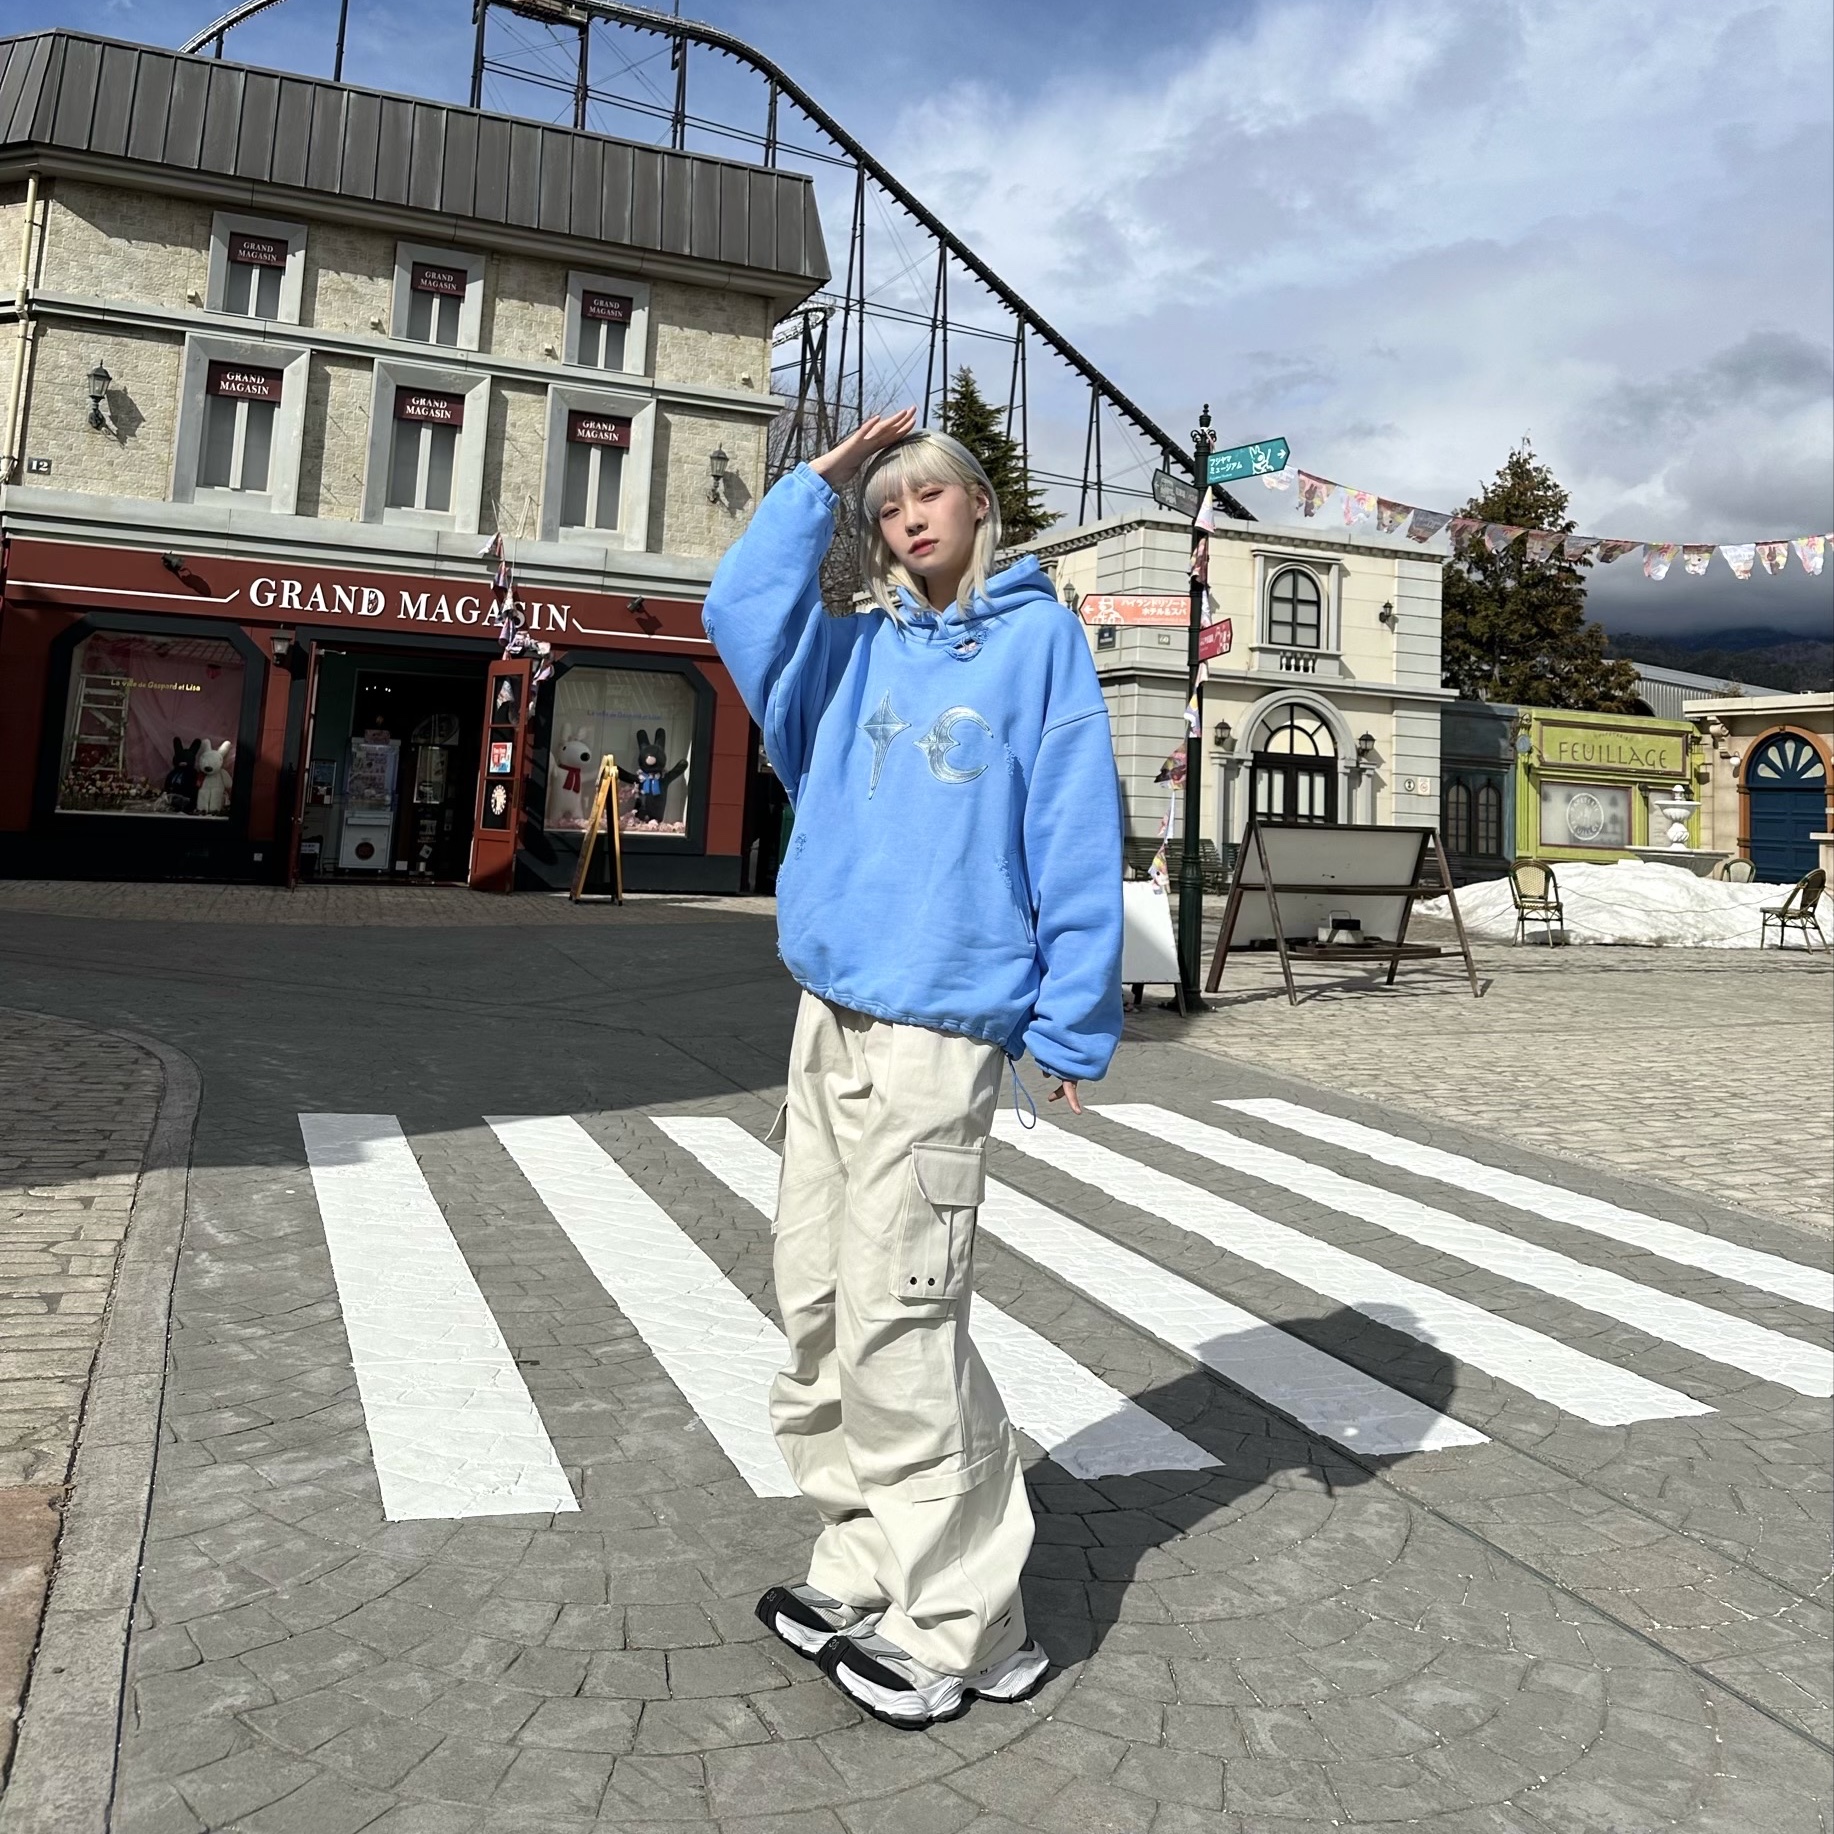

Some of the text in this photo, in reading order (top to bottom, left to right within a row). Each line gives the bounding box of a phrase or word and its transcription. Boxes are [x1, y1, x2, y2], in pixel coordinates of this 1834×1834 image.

[243, 242, 274, 253] GRAND
[238, 249, 277, 261] MAGASIN
[425, 271, 454, 282] GRAND
[420, 278, 457, 291] MAGASIN
[593, 299, 620, 309] GRAND
[589, 306, 623, 317] MAGASIN
[226, 371, 265, 384] GRAND
[220, 380, 270, 395] MAGASIN
[411, 396, 447, 409] GRAND
[405, 405, 452, 419] MAGASIN
[582, 420, 615, 432] GRAND
[577, 428, 620, 441] MAGASIN
[31, 460, 49, 471] 12
[1209, 455, 1232, 467] フジヤマ
[1209, 461, 1243, 475] ミュージアム
[249, 577, 386, 617] GRAND
[185, 683, 201, 692] Lisa
[1559, 742, 1667, 769] FEUILLAGE
